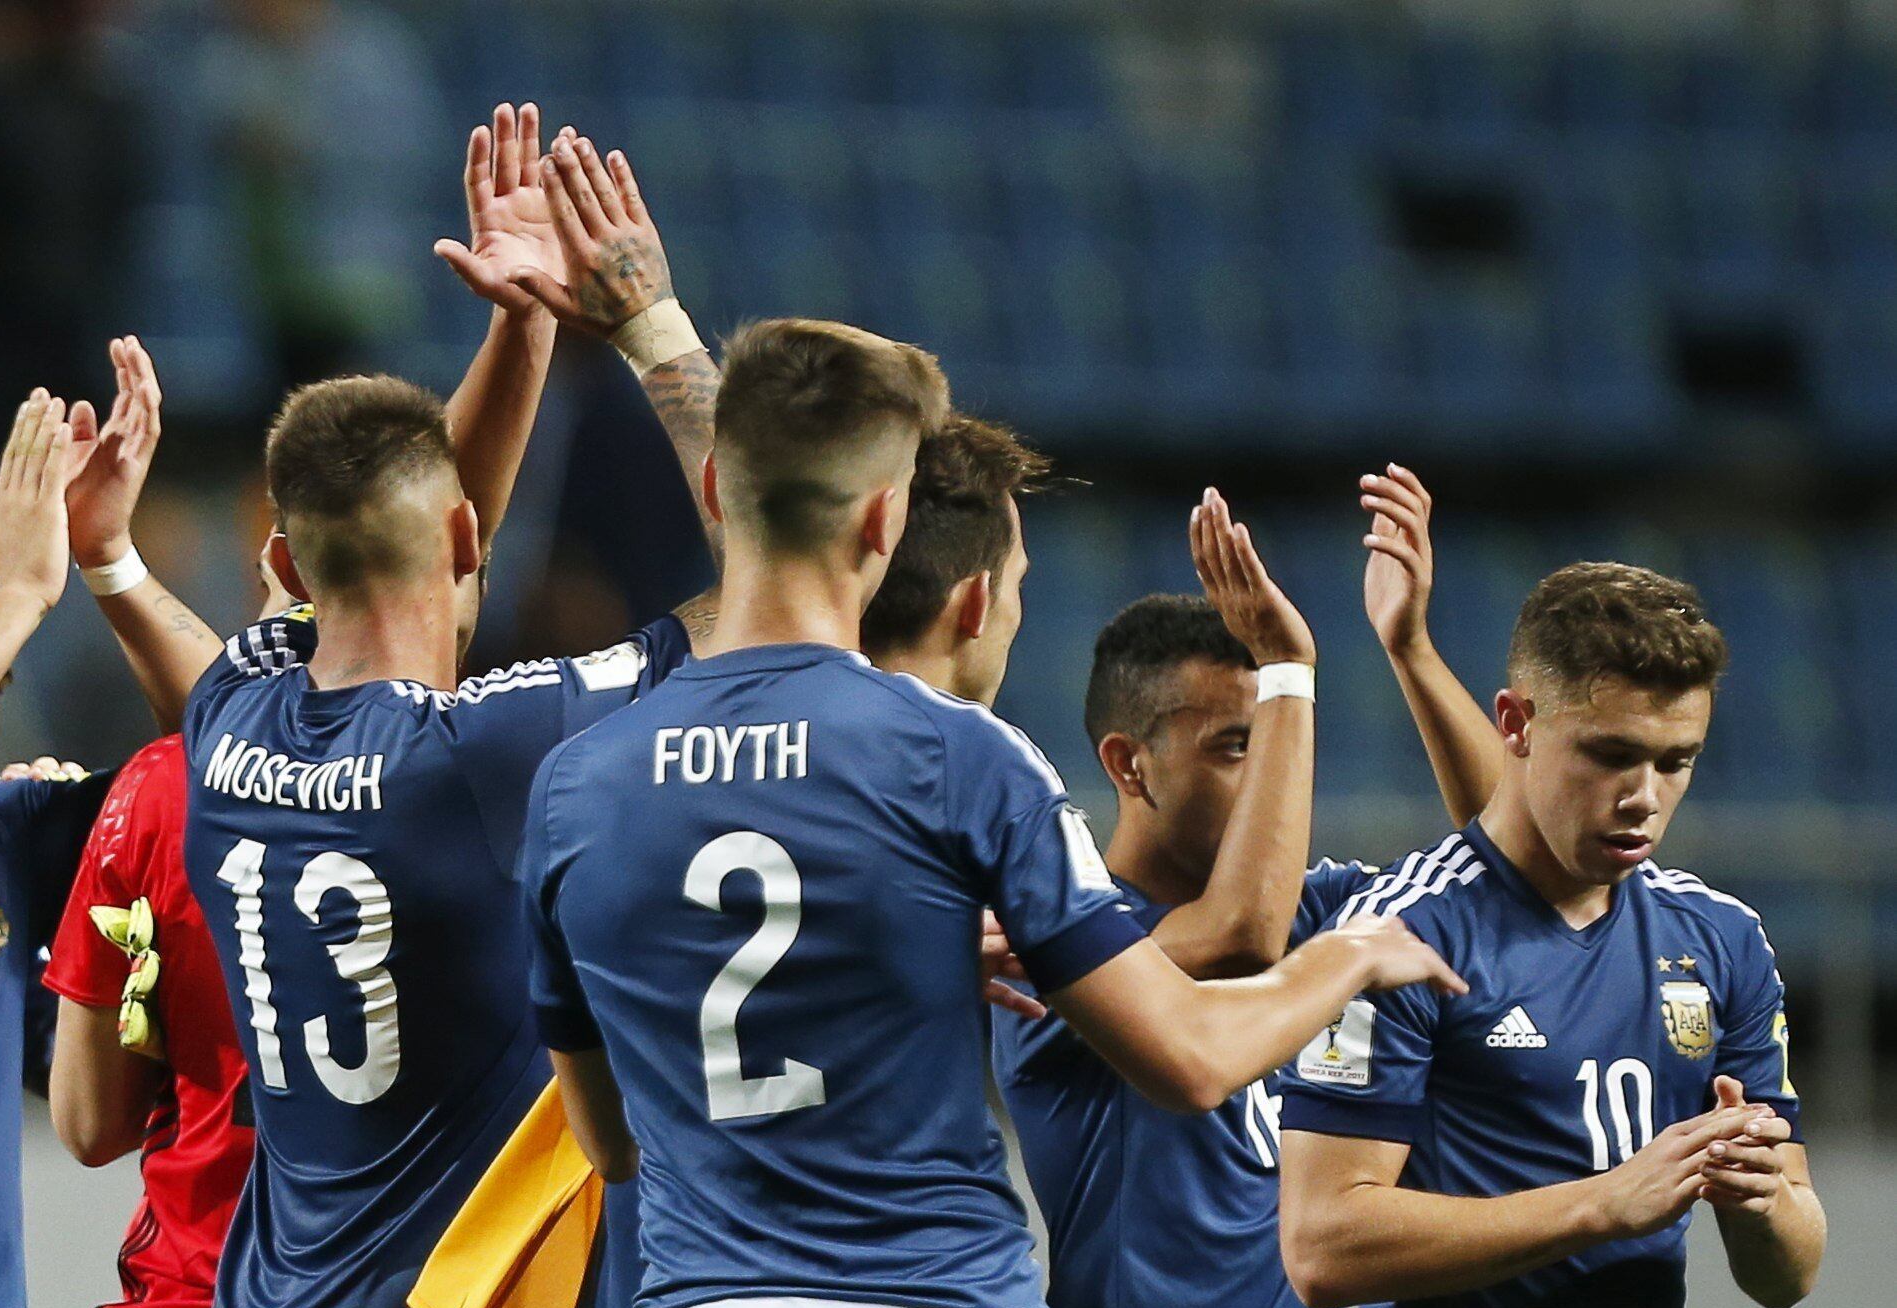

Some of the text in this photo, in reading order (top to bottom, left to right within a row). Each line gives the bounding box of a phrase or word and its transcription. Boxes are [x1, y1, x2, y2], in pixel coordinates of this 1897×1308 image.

[203, 732, 384, 813] MOSEVICH
[654, 720, 809, 784] FOYTH
[216, 837, 402, 1105] 13
[684, 830, 827, 1121] 2
[1486, 1033, 1547, 1048] adidas
[1678, 1006, 1707, 1037] AFA
[1575, 1058, 1654, 1171] 10
